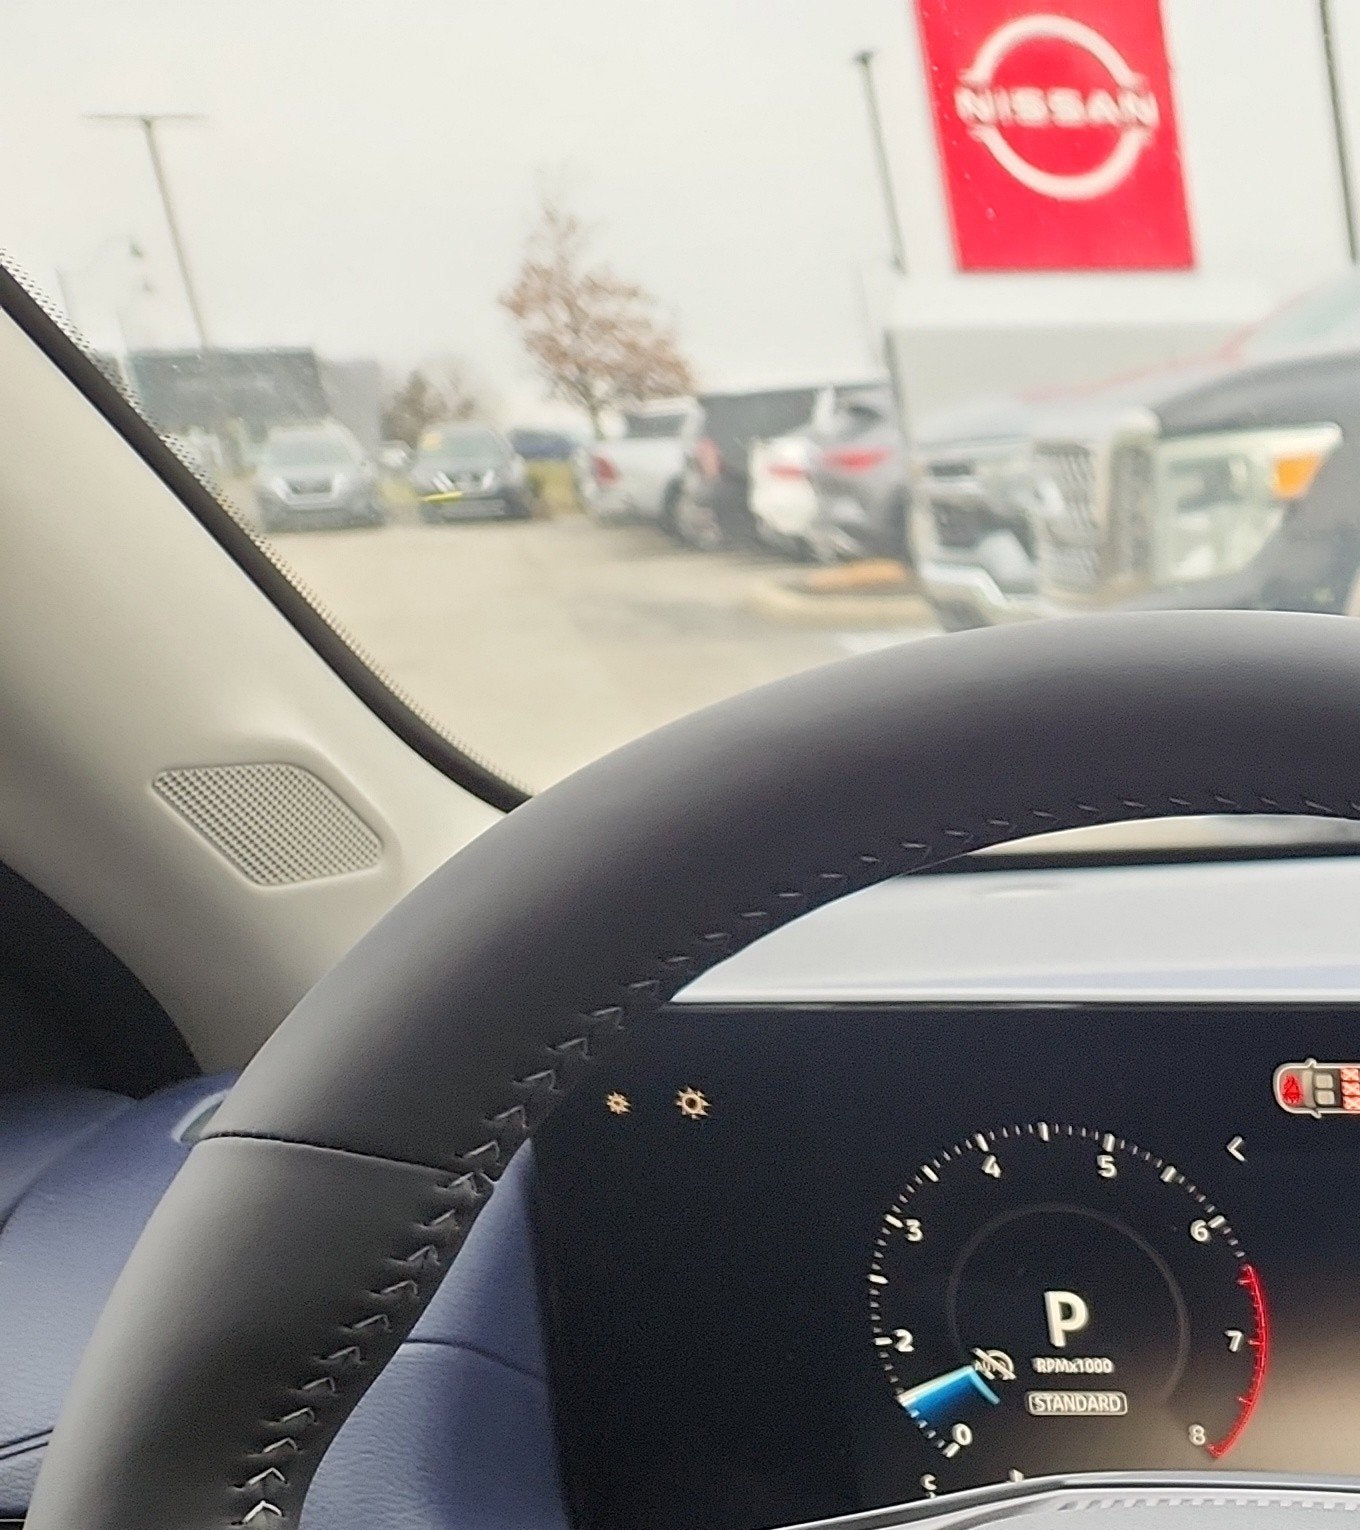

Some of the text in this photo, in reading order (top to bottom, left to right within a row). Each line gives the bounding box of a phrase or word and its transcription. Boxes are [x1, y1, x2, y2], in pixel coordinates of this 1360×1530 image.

[954, 84, 1160, 128] NISSAN
[982, 1155, 1001, 1179] 4
[1097, 1154, 1117, 1179] 5
[905, 1218, 924, 1243] 3
[1190, 1219, 1210, 1243] 6
[1044, 1290, 1089, 1348] P
[895, 1329, 914, 1352] 2
[1227, 1330, 1244, 1353] 7
[1033, 1393, 1121, 1413] STANDARD
[952, 1423, 973, 1446] 0
[1188, 1424, 1207, 1447] 8
